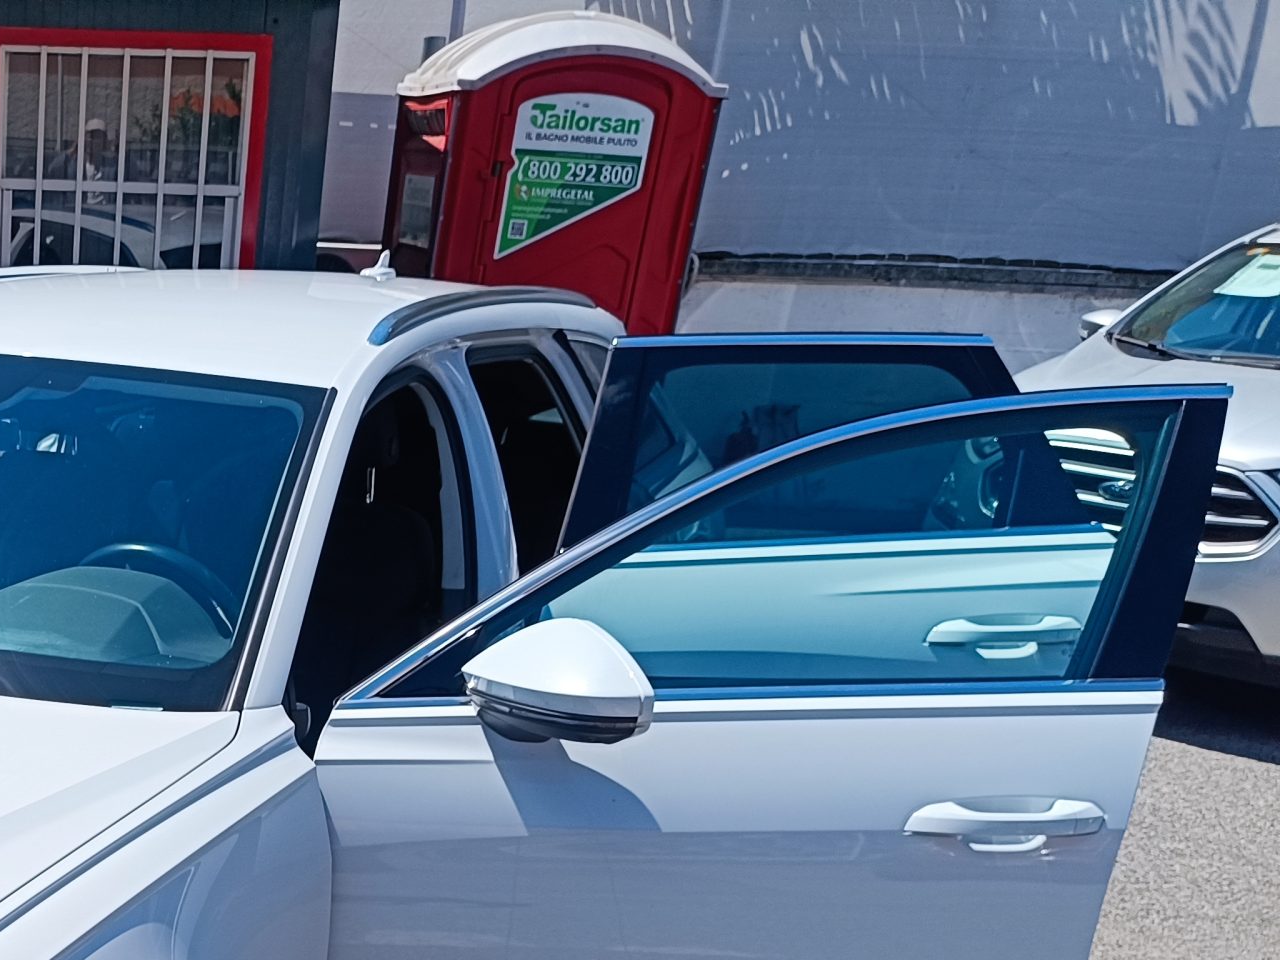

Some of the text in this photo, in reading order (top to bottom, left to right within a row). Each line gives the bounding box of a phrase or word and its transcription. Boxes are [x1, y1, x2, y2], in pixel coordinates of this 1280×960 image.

[530, 103, 640, 135] Tailorsan
[525, 132, 638, 147] IL BAGNO MOBILE PULITO
[528, 160, 632, 186] 800 292 800
